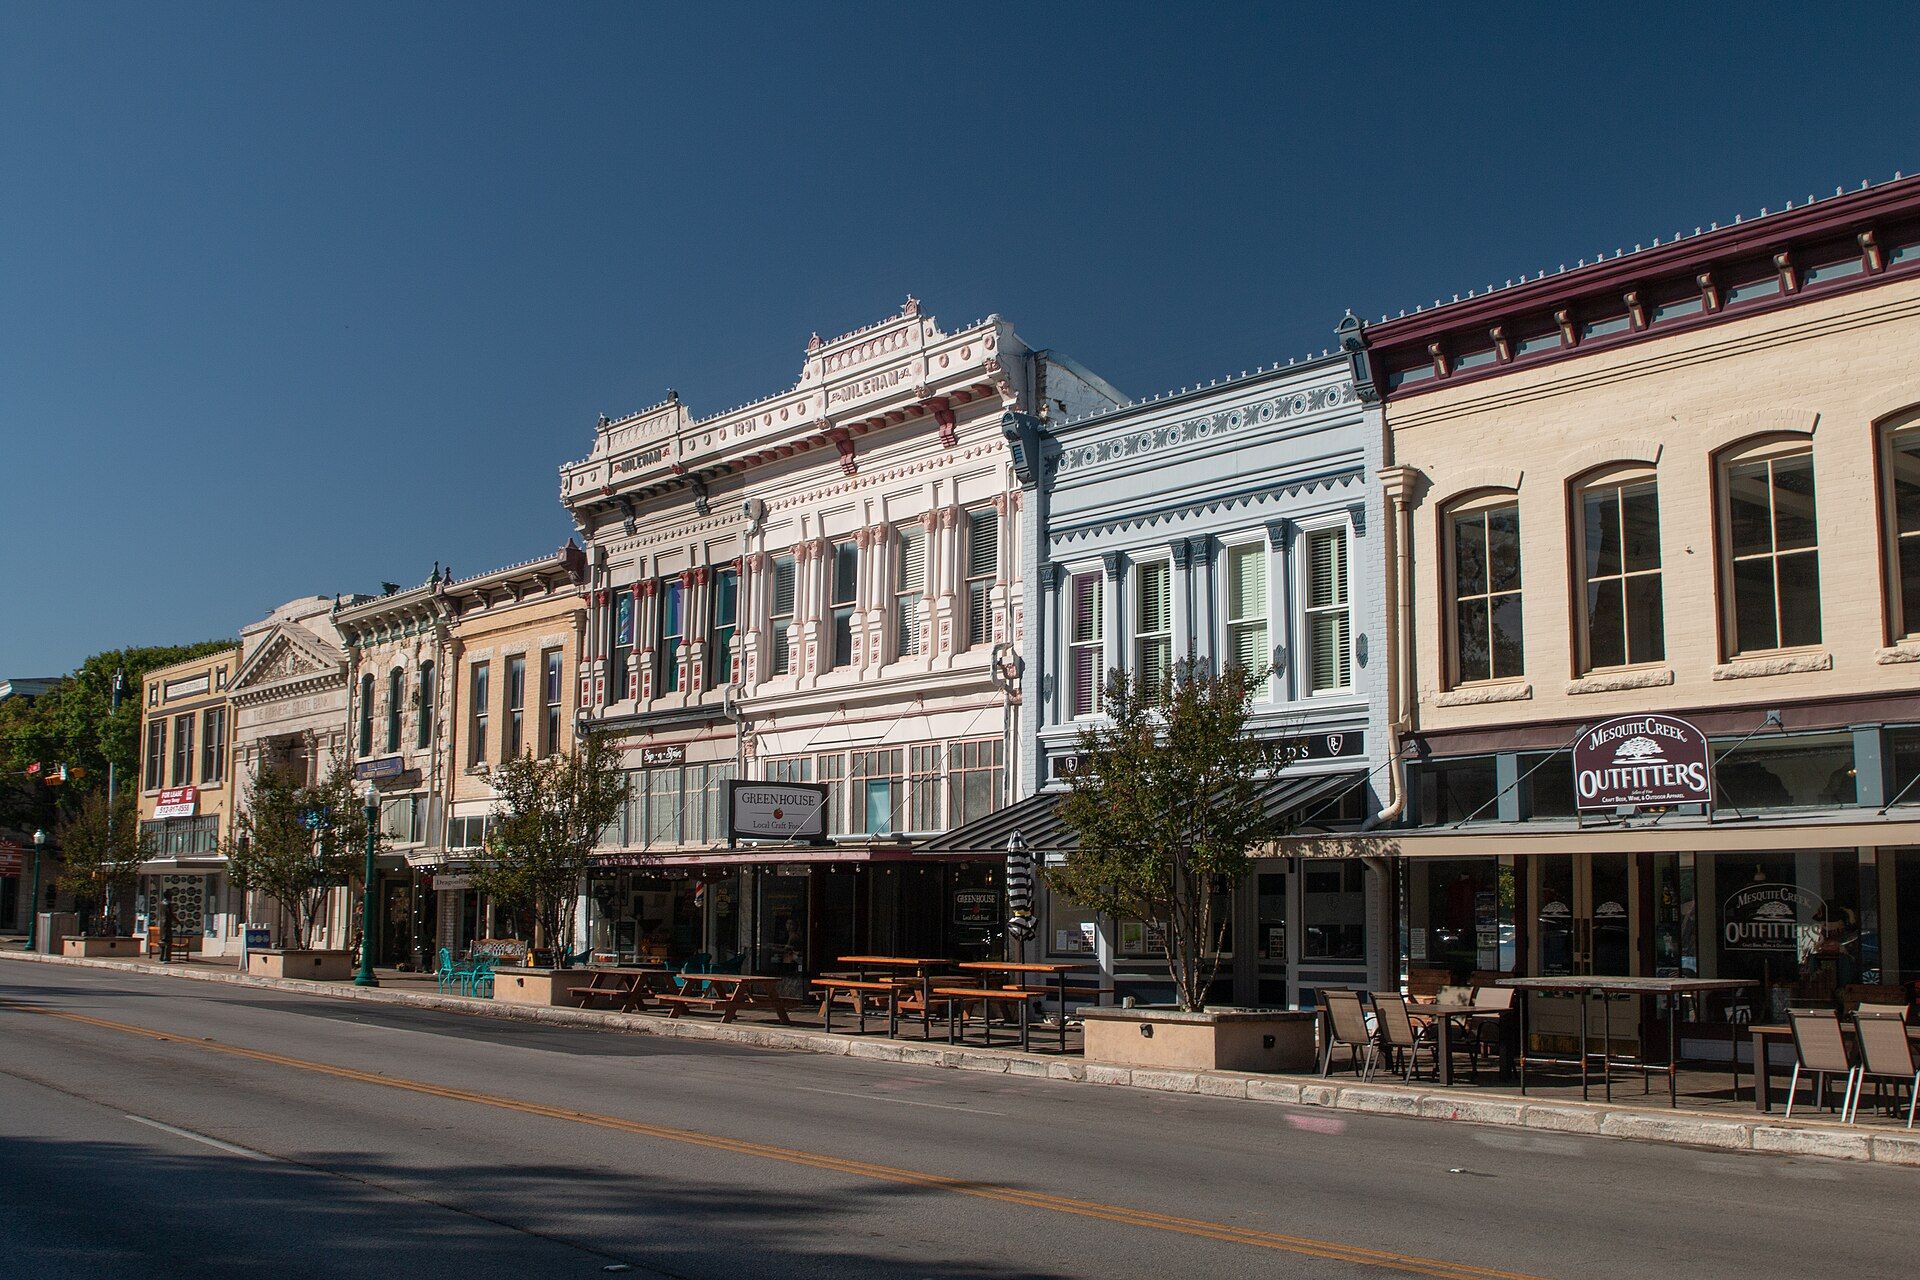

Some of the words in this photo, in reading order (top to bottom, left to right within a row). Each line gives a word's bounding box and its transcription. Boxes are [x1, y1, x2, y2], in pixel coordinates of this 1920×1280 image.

[841, 370, 899, 402] MILEHAM
[734, 418, 756, 437] 1891
[621, 449, 662, 473] MILEHAM
[253, 709, 263, 721] THE
[292, 699, 311, 714] STATE
[312, 696, 329, 710] BANK
[1578, 762, 1708, 799] OUTFITTERS
[161, 791, 170, 799] FOR
[170, 789, 184, 798] LEASE
[741, 792, 815, 807] GREENHOUSE
[753, 821, 770, 829] Local
[771, 821, 787, 829] Craft
[956, 894, 996, 904] GREENHOUSE
[1725, 921, 1823, 943] OUTFITTERS
